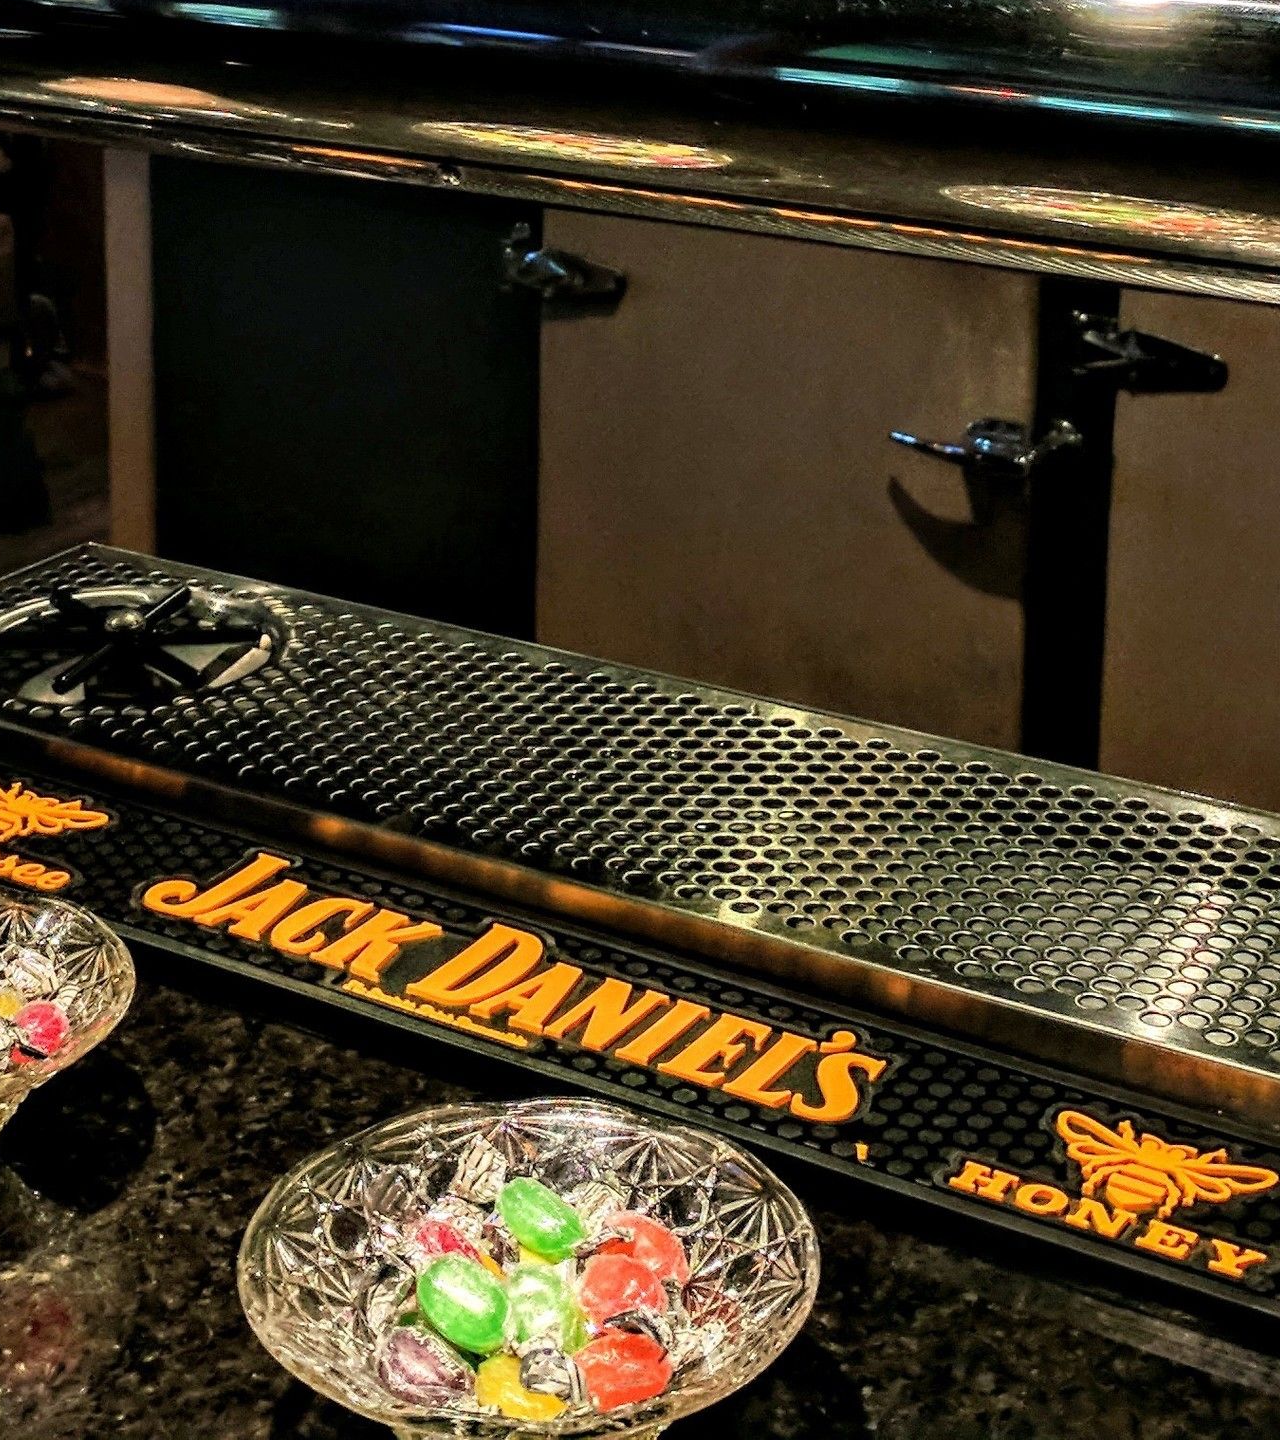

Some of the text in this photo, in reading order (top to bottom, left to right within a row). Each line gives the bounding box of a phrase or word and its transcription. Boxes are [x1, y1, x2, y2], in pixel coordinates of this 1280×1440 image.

[143, 852, 443, 982] JACK
[406, 922, 887, 1123] DANIEL'S
[949, 1161, 1268, 1278] HONEY
